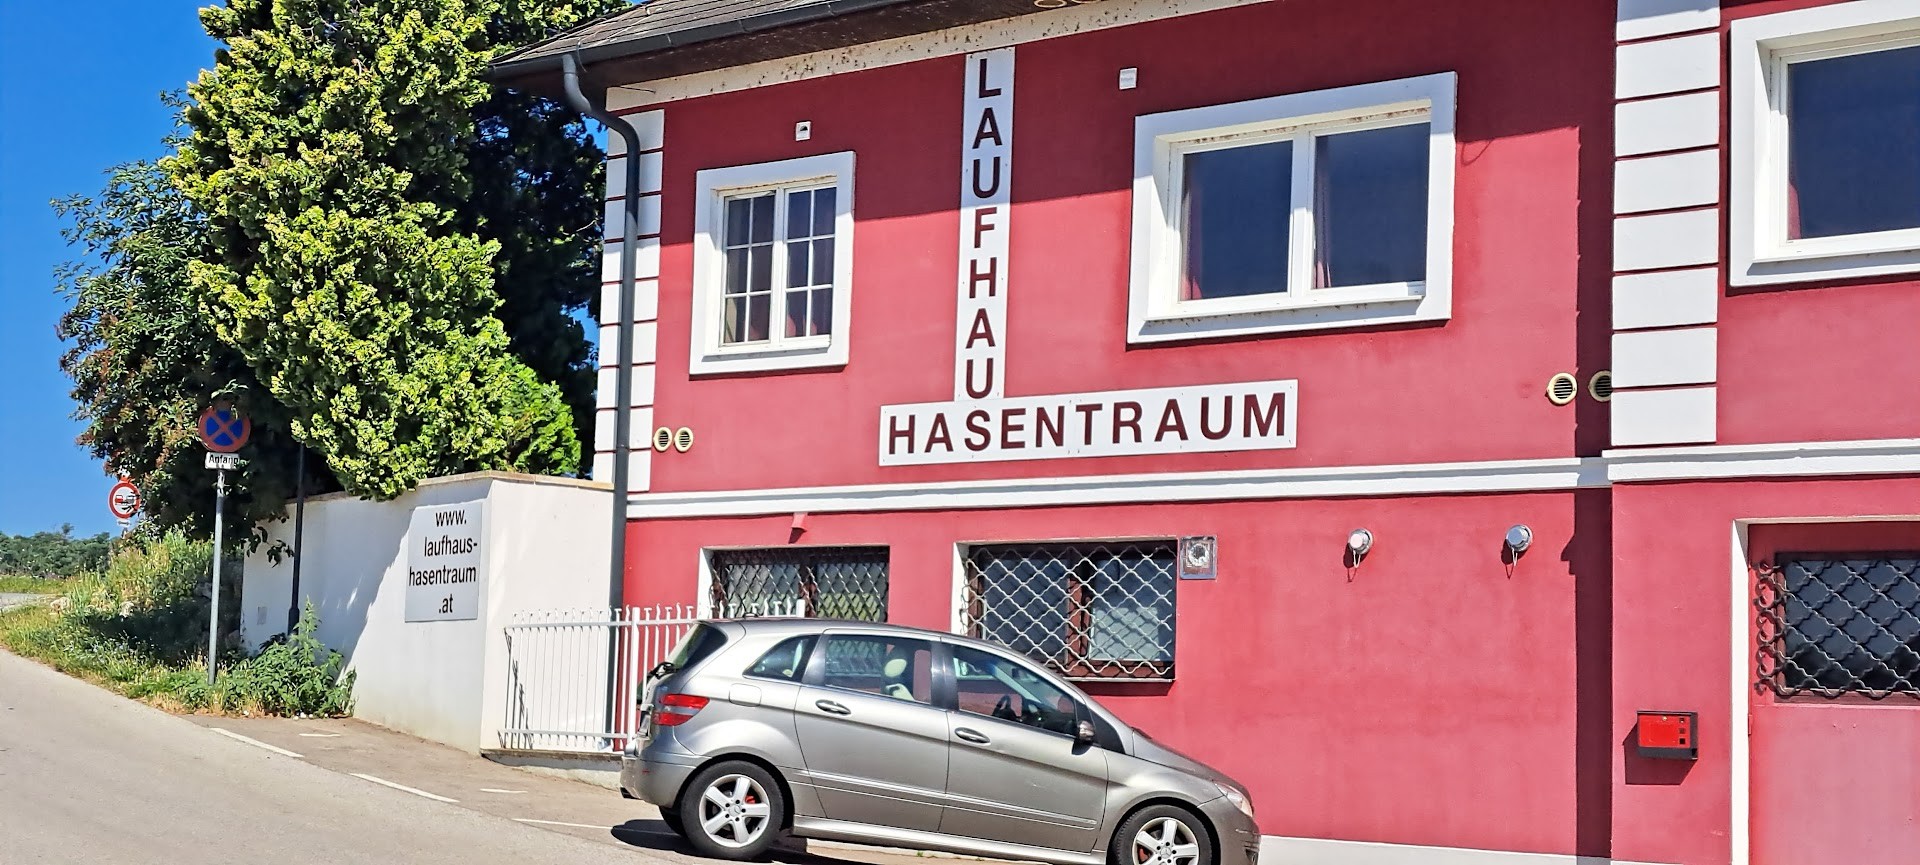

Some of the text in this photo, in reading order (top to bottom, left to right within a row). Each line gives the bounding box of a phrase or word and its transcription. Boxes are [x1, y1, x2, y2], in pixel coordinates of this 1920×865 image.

[888, 392, 1286, 455] HASENTRAUM
[435, 509, 467, 527] www.
[424, 535, 478, 557] laufhaus-
[408, 565, 477, 587] hasentraum
[438, 593, 454, 614] .at
